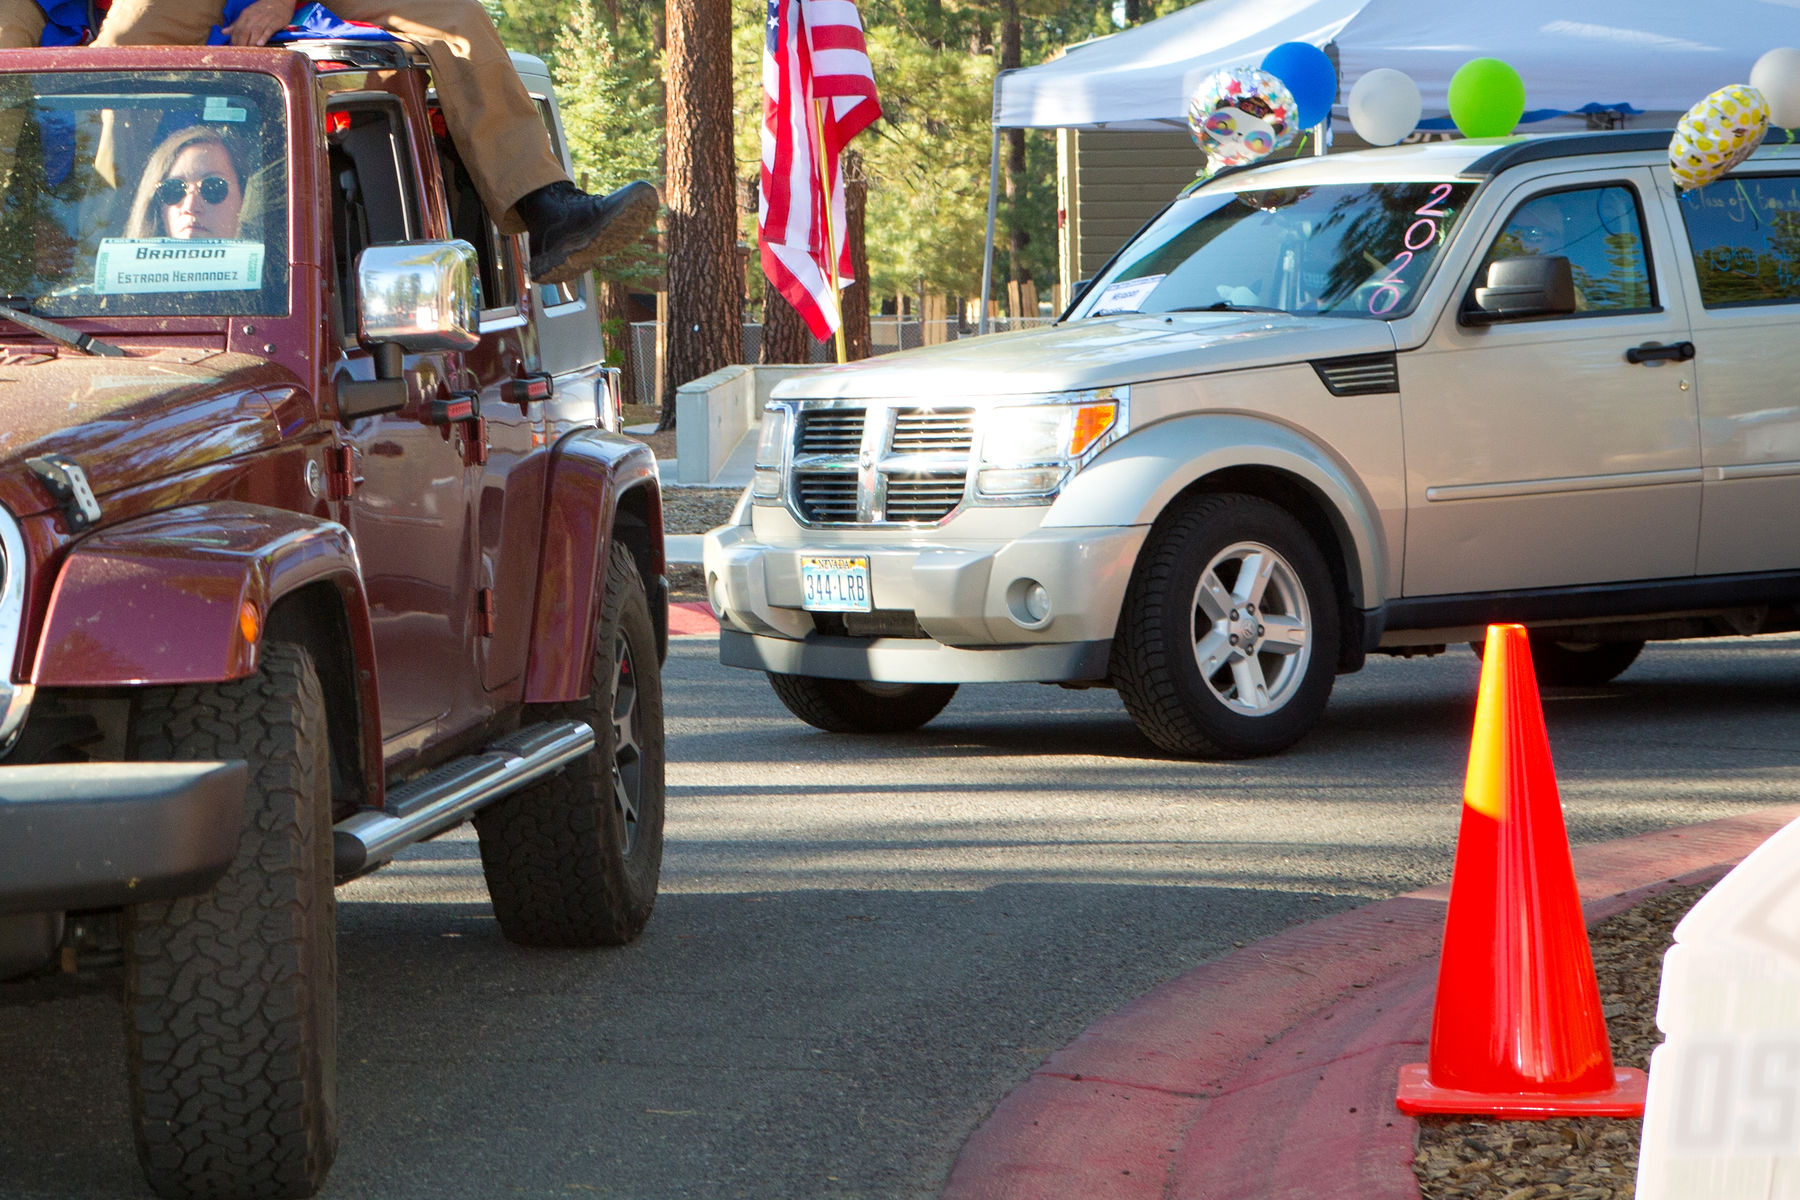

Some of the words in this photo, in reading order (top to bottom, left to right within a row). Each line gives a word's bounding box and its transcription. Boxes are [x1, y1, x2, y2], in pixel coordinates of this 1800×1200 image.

[135, 247, 227, 260] BRANDON
[1368, 183, 1453, 315] 2020
[117, 271, 170, 285] ESTRADA
[172, 270, 239, 283] HERNANDEZ
[817, 559, 851, 570] NEVADA
